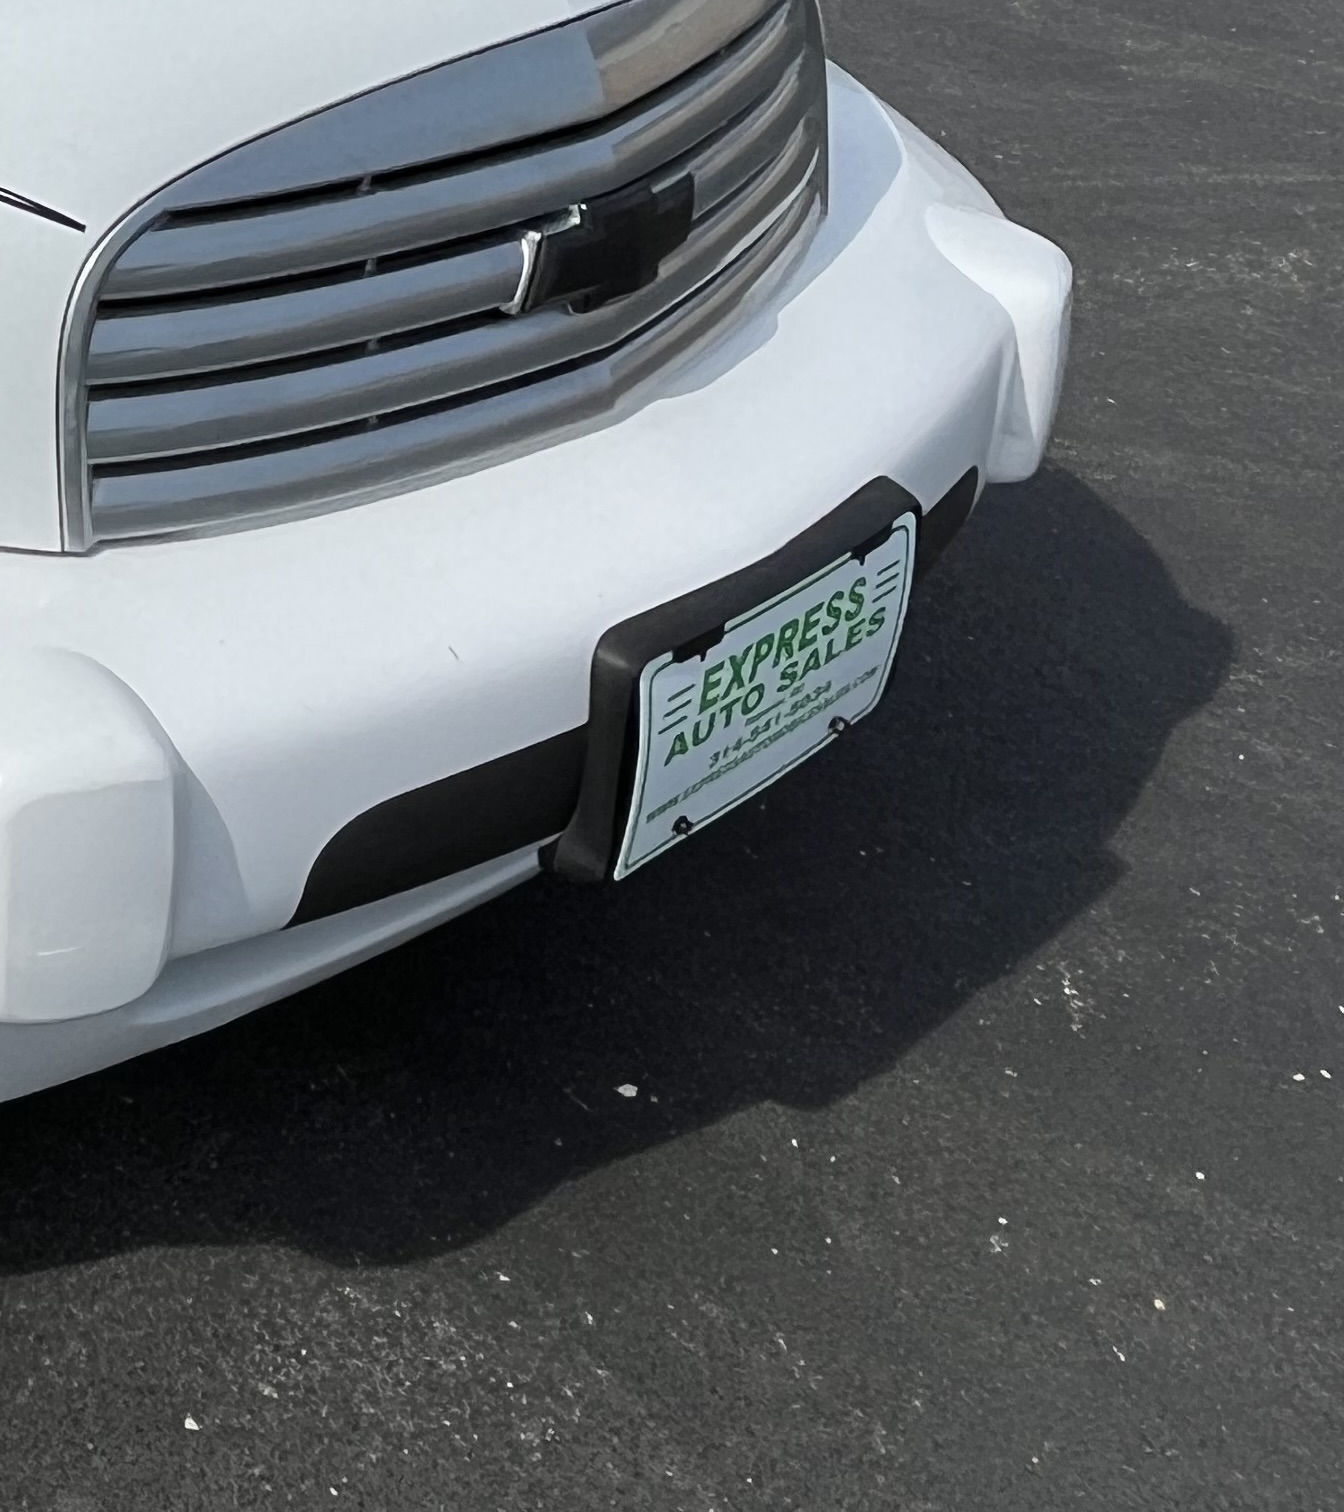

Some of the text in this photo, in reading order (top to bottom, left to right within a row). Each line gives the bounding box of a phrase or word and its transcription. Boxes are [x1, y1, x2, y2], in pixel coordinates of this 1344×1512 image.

[663, 682, 765, 767] AUTO
[776, 606, 887, 693] SALES
[698, 576, 867, 716] EXPRESS
